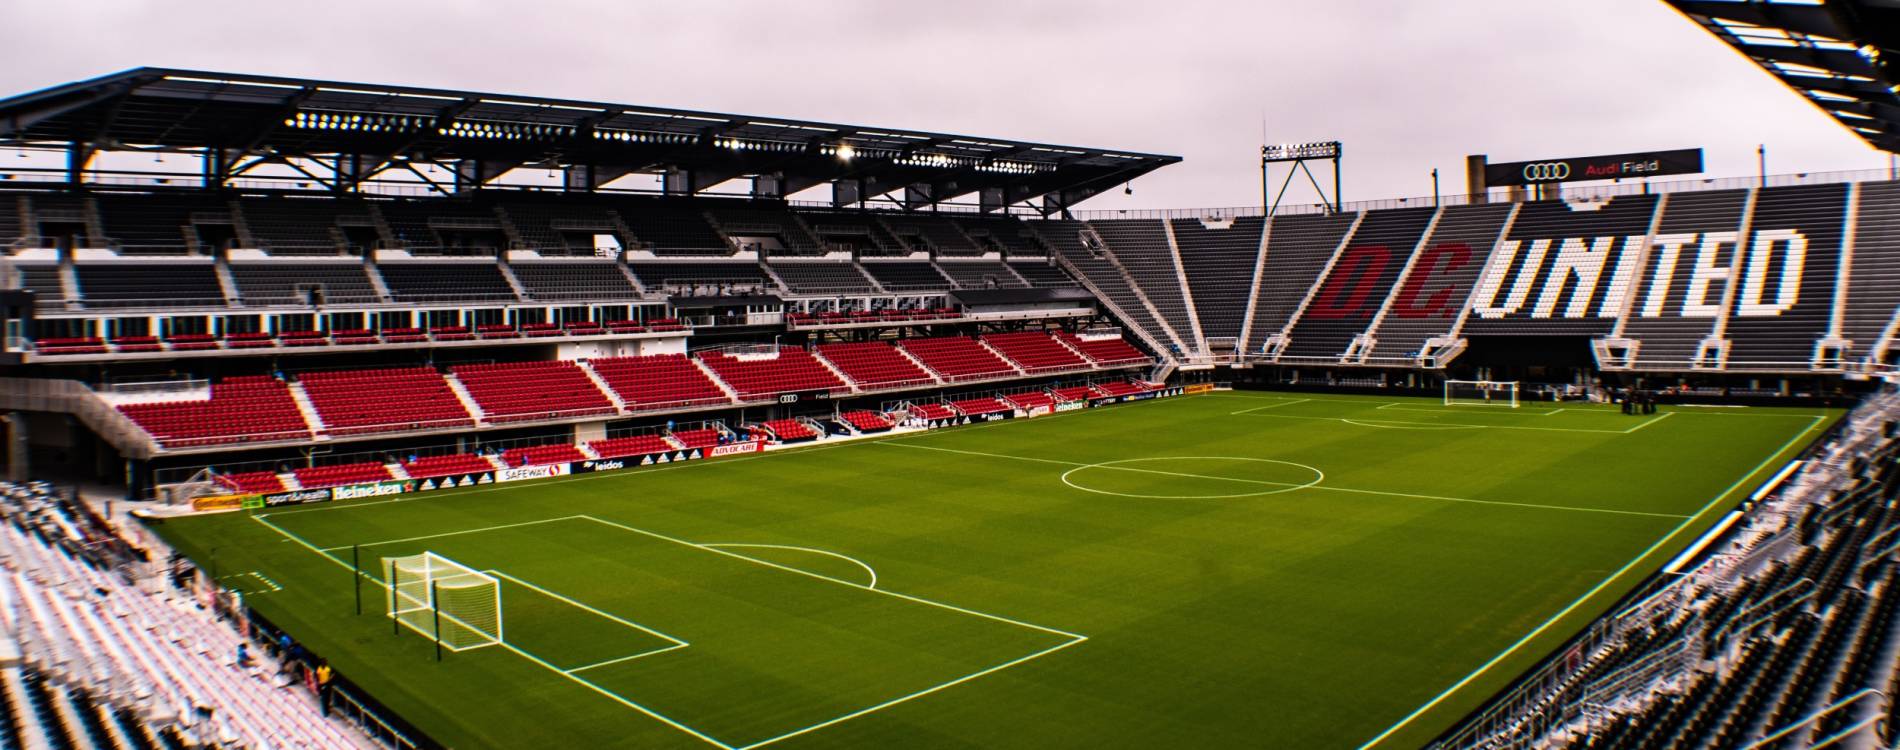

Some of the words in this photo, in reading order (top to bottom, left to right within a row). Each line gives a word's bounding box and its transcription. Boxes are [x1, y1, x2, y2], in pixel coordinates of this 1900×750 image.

[1585, 163, 1619, 176] Audi
[1622, 160, 1659, 173] Field
[1472, 229, 1808, 318] UNITED
[714, 442, 756, 455] ADVOCARE
[505, 466, 547, 480] SAFEWAY
[595, 460, 624, 471] leidos
[333, 483, 402, 500] Heineken
